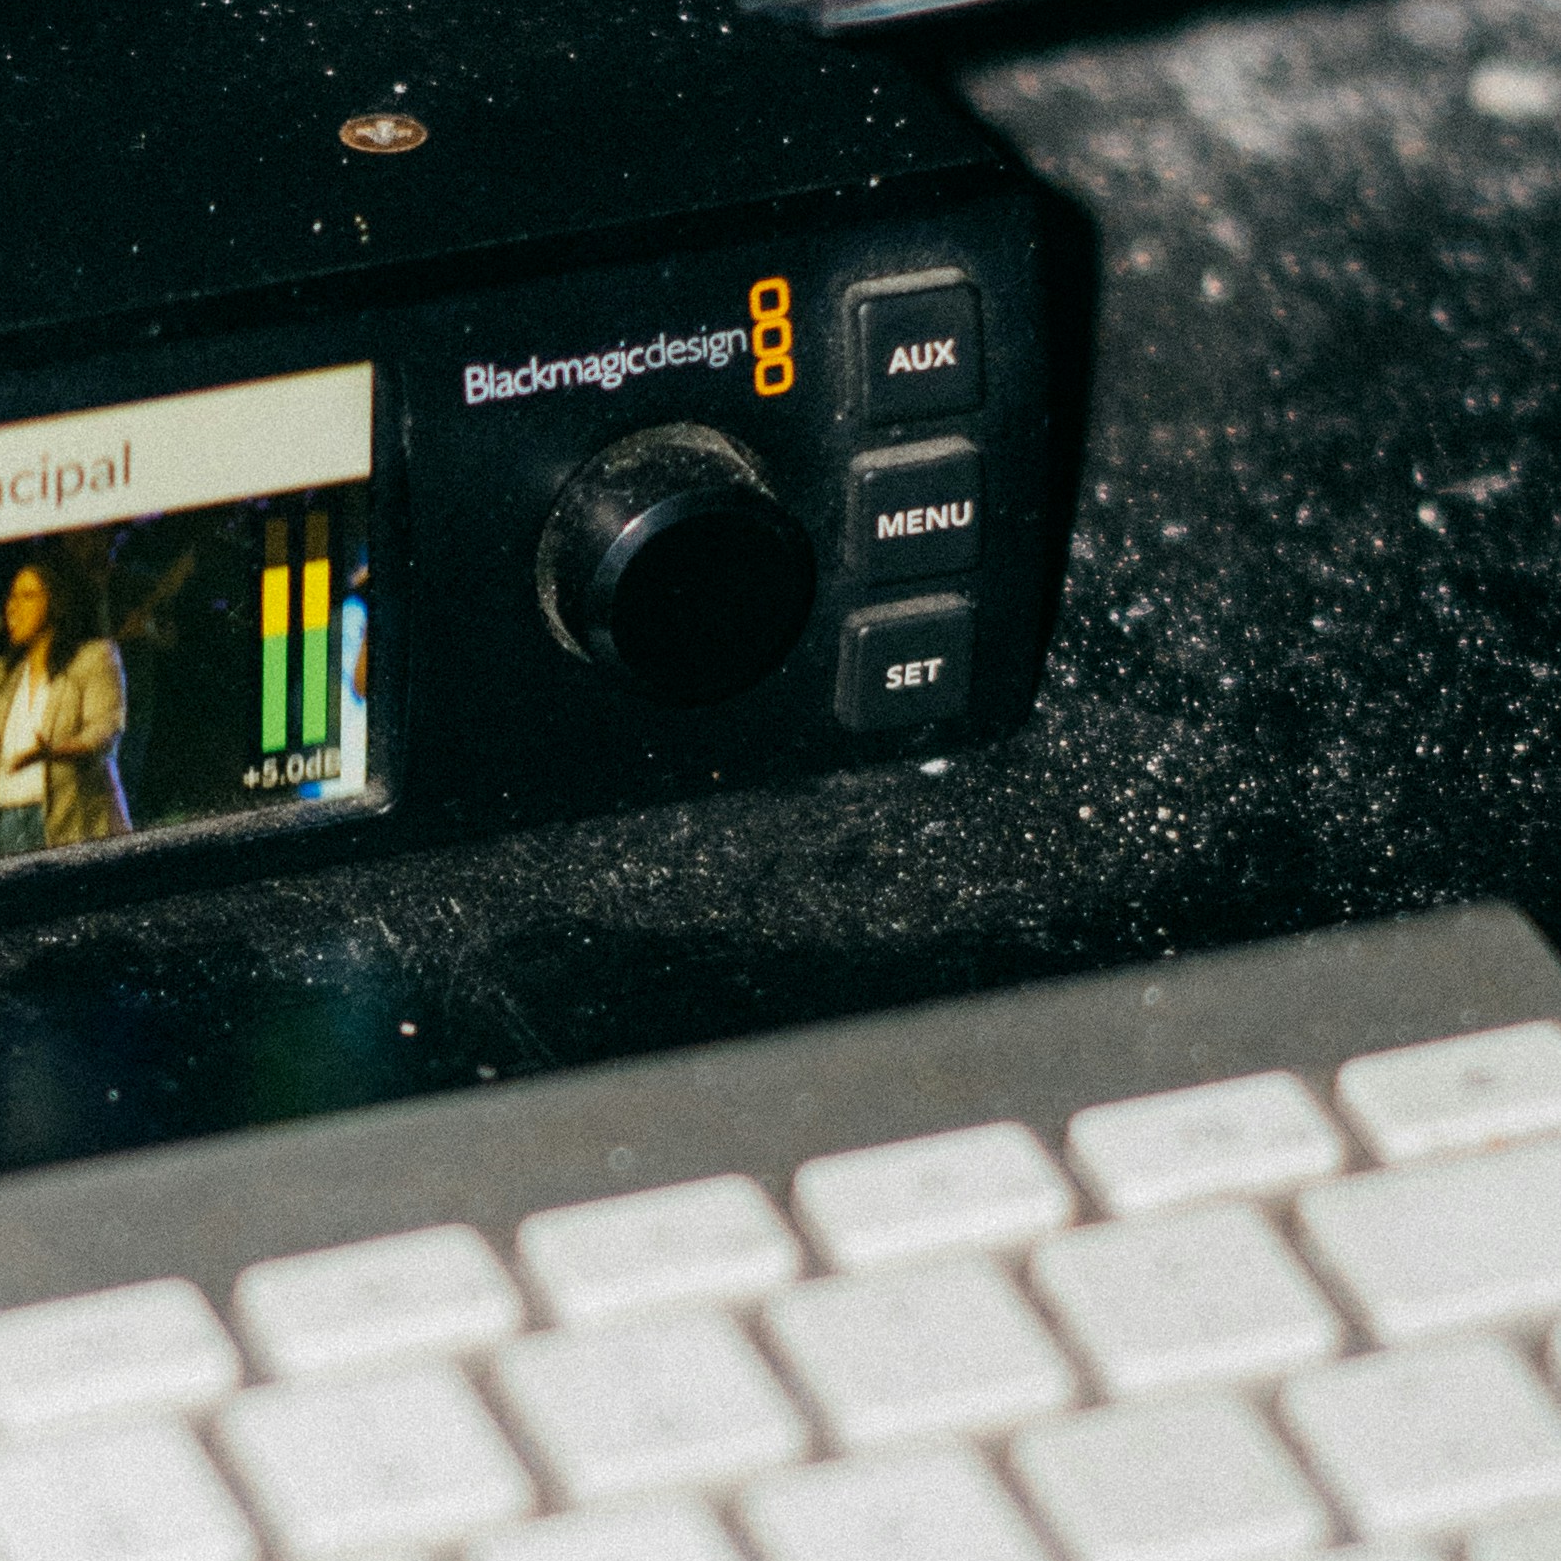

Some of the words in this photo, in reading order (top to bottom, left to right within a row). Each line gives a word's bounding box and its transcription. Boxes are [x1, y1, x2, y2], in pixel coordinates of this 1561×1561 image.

[464, 327, 748, 404] Blackmagicdesign
[889, 339, 956, 375] AUX
[877, 501, 973, 539] MENU
[885, 659, 942, 689] SET
